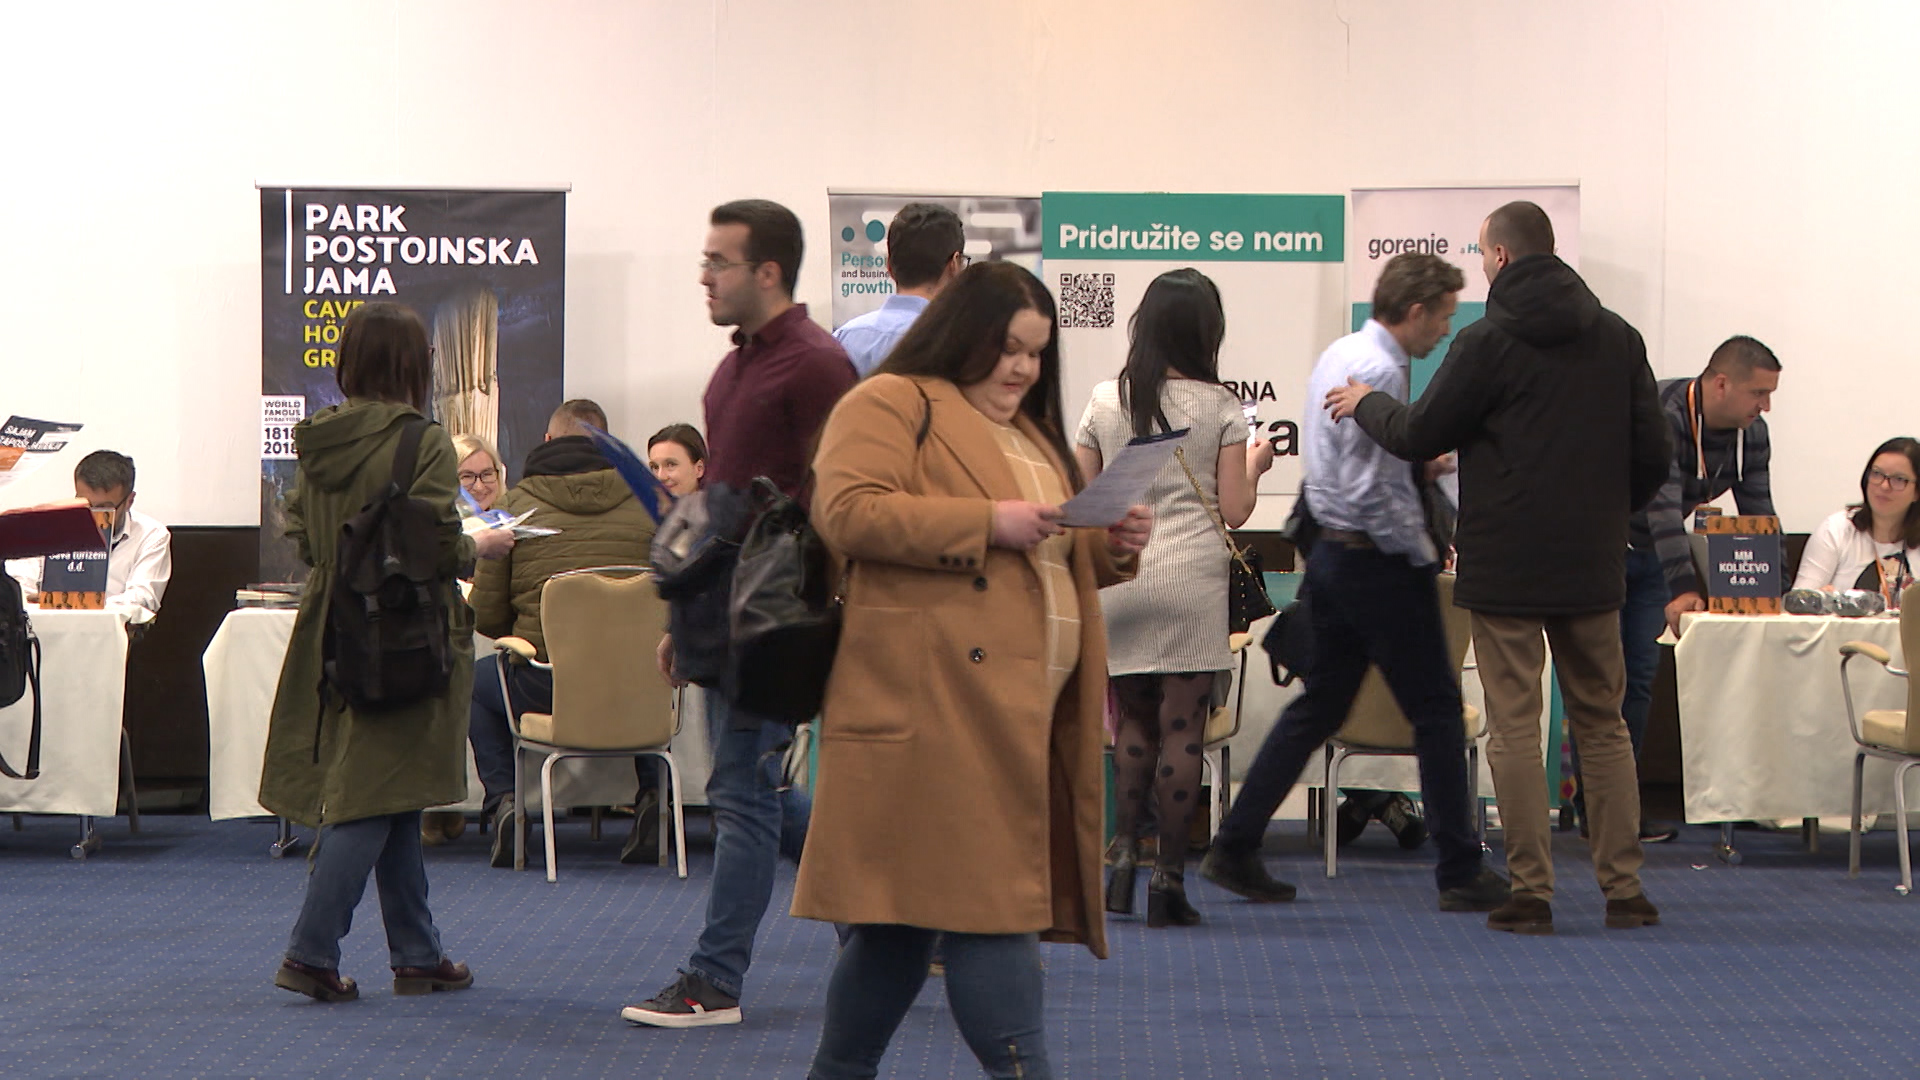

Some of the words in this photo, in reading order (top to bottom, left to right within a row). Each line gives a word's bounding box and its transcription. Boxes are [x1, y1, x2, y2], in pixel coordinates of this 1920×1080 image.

[305, 203, 407, 232] PARK
[305, 235, 539, 265] POSTOJNSKA
[1059, 223, 1201, 251] Pridružite
[1209, 230, 1244, 251] se
[1253, 231, 1323, 252] nam
[1368, 232, 1449, 260] gorenje
[841, 251, 888, 268] Perso
[303, 267, 397, 294] JAMA
[841, 269, 858, 278] and
[841, 280, 893, 298] growth
[304, 319, 345, 344] HÖ
[1255, 419, 1299, 457] a
[1719, 561, 1769, 573] KOLIČEVO
[1729, 575, 1759, 585] d.o.o.
